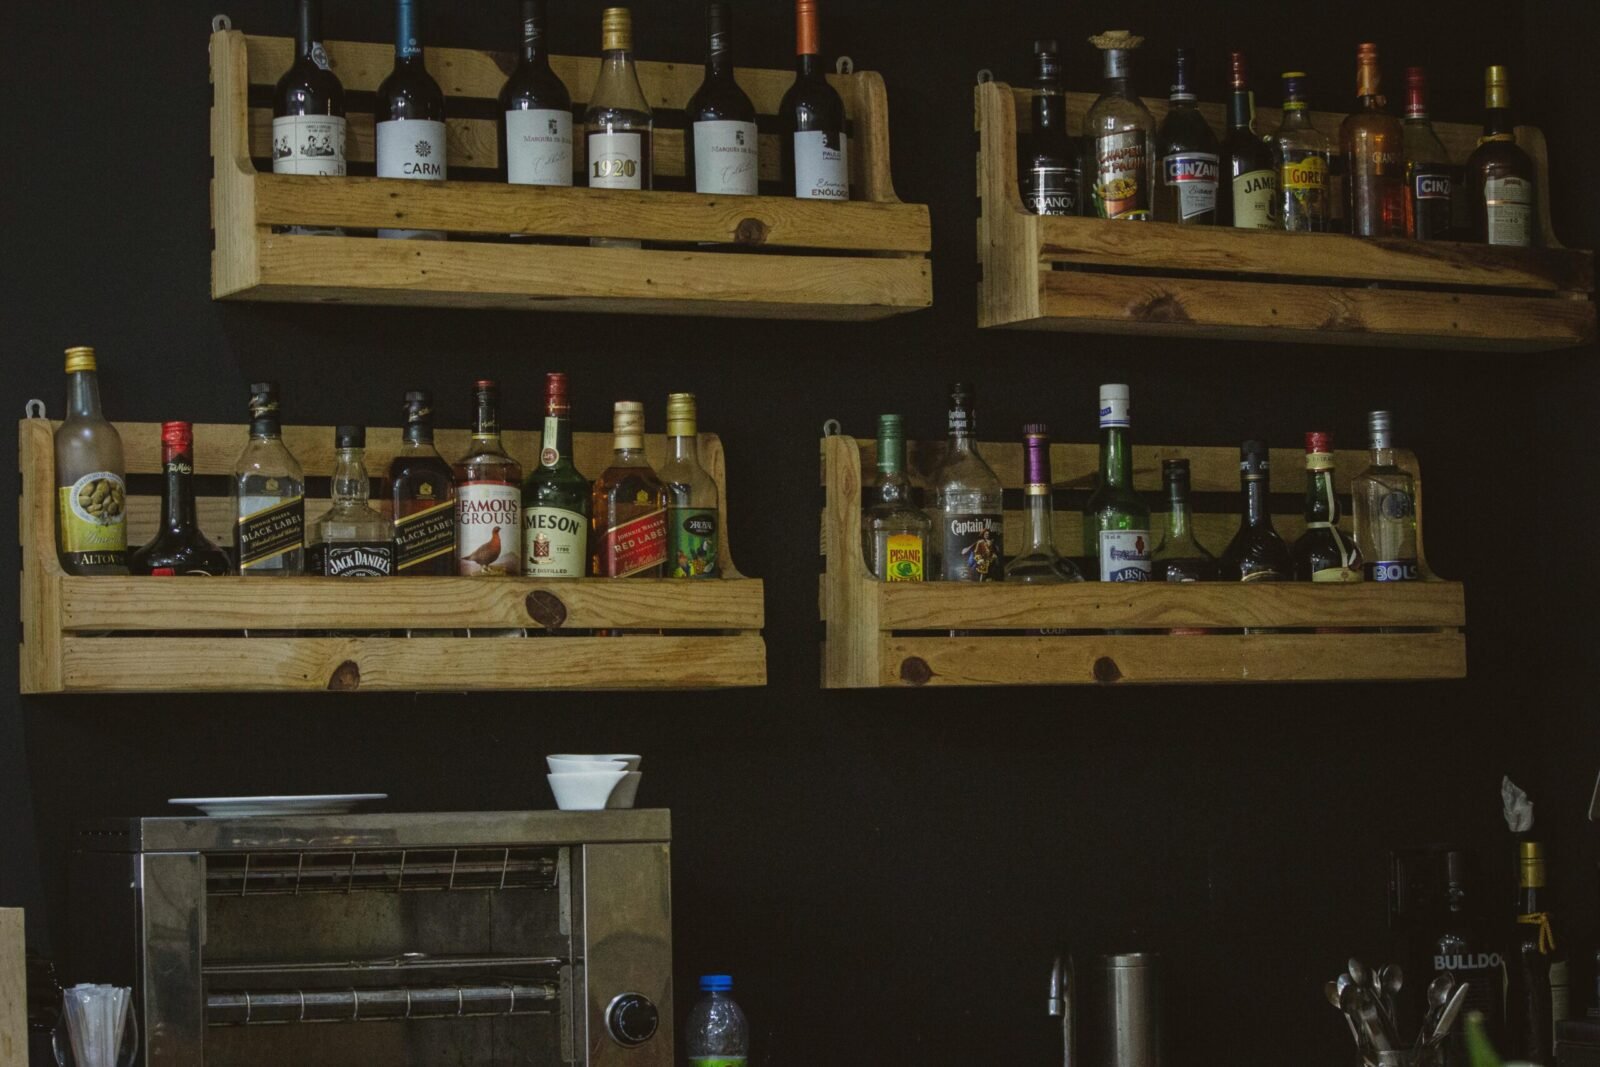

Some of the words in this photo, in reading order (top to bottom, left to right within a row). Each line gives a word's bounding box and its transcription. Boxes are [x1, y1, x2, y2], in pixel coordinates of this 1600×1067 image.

[403, 162, 441, 176] CARM
[593, 159, 636, 178] 1920
[461, 499, 518, 513] FAMOUS
[460, 512, 518, 525] GROUSE
[242, 525, 274, 543] BLACK
[274, 514, 303, 531] LABEL
[951, 517, 984, 537] Captain
[396, 529, 427, 545] BLACK
[614, 540, 635, 553] RED
[330, 554, 355, 575] JACK
[354, 550, 391, 575] DANIEL'S
[890, 549, 920, 564] PISANG
[1433, 953, 1502, 971] BULLDO
